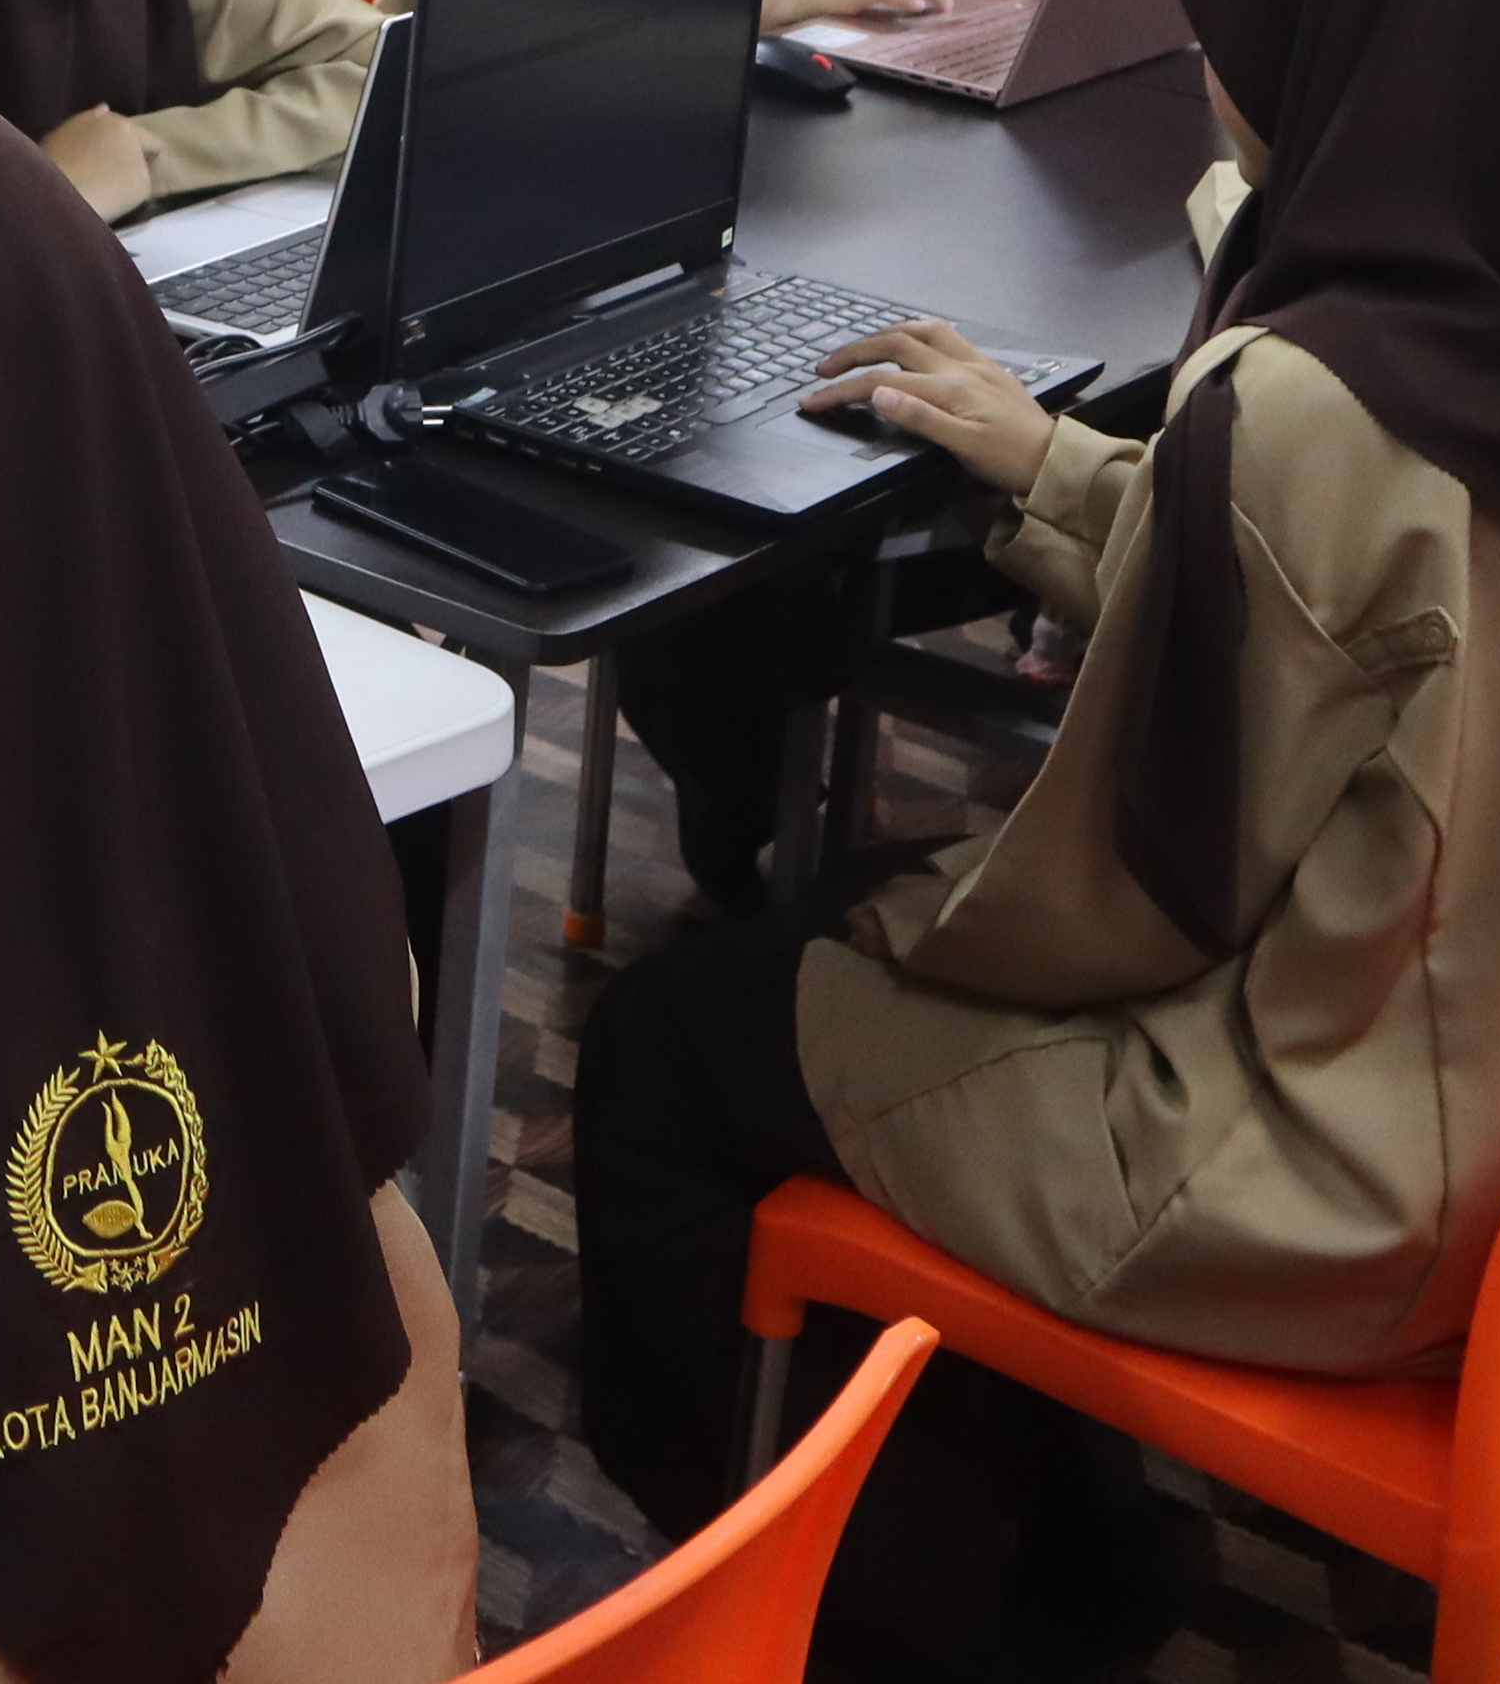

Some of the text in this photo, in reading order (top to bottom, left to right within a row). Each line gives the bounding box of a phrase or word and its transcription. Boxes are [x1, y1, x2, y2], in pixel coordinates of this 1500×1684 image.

[66, 1293, 196, 1383] MAN 2
[80, 1300, 262, 1431] BANJARMASIN
